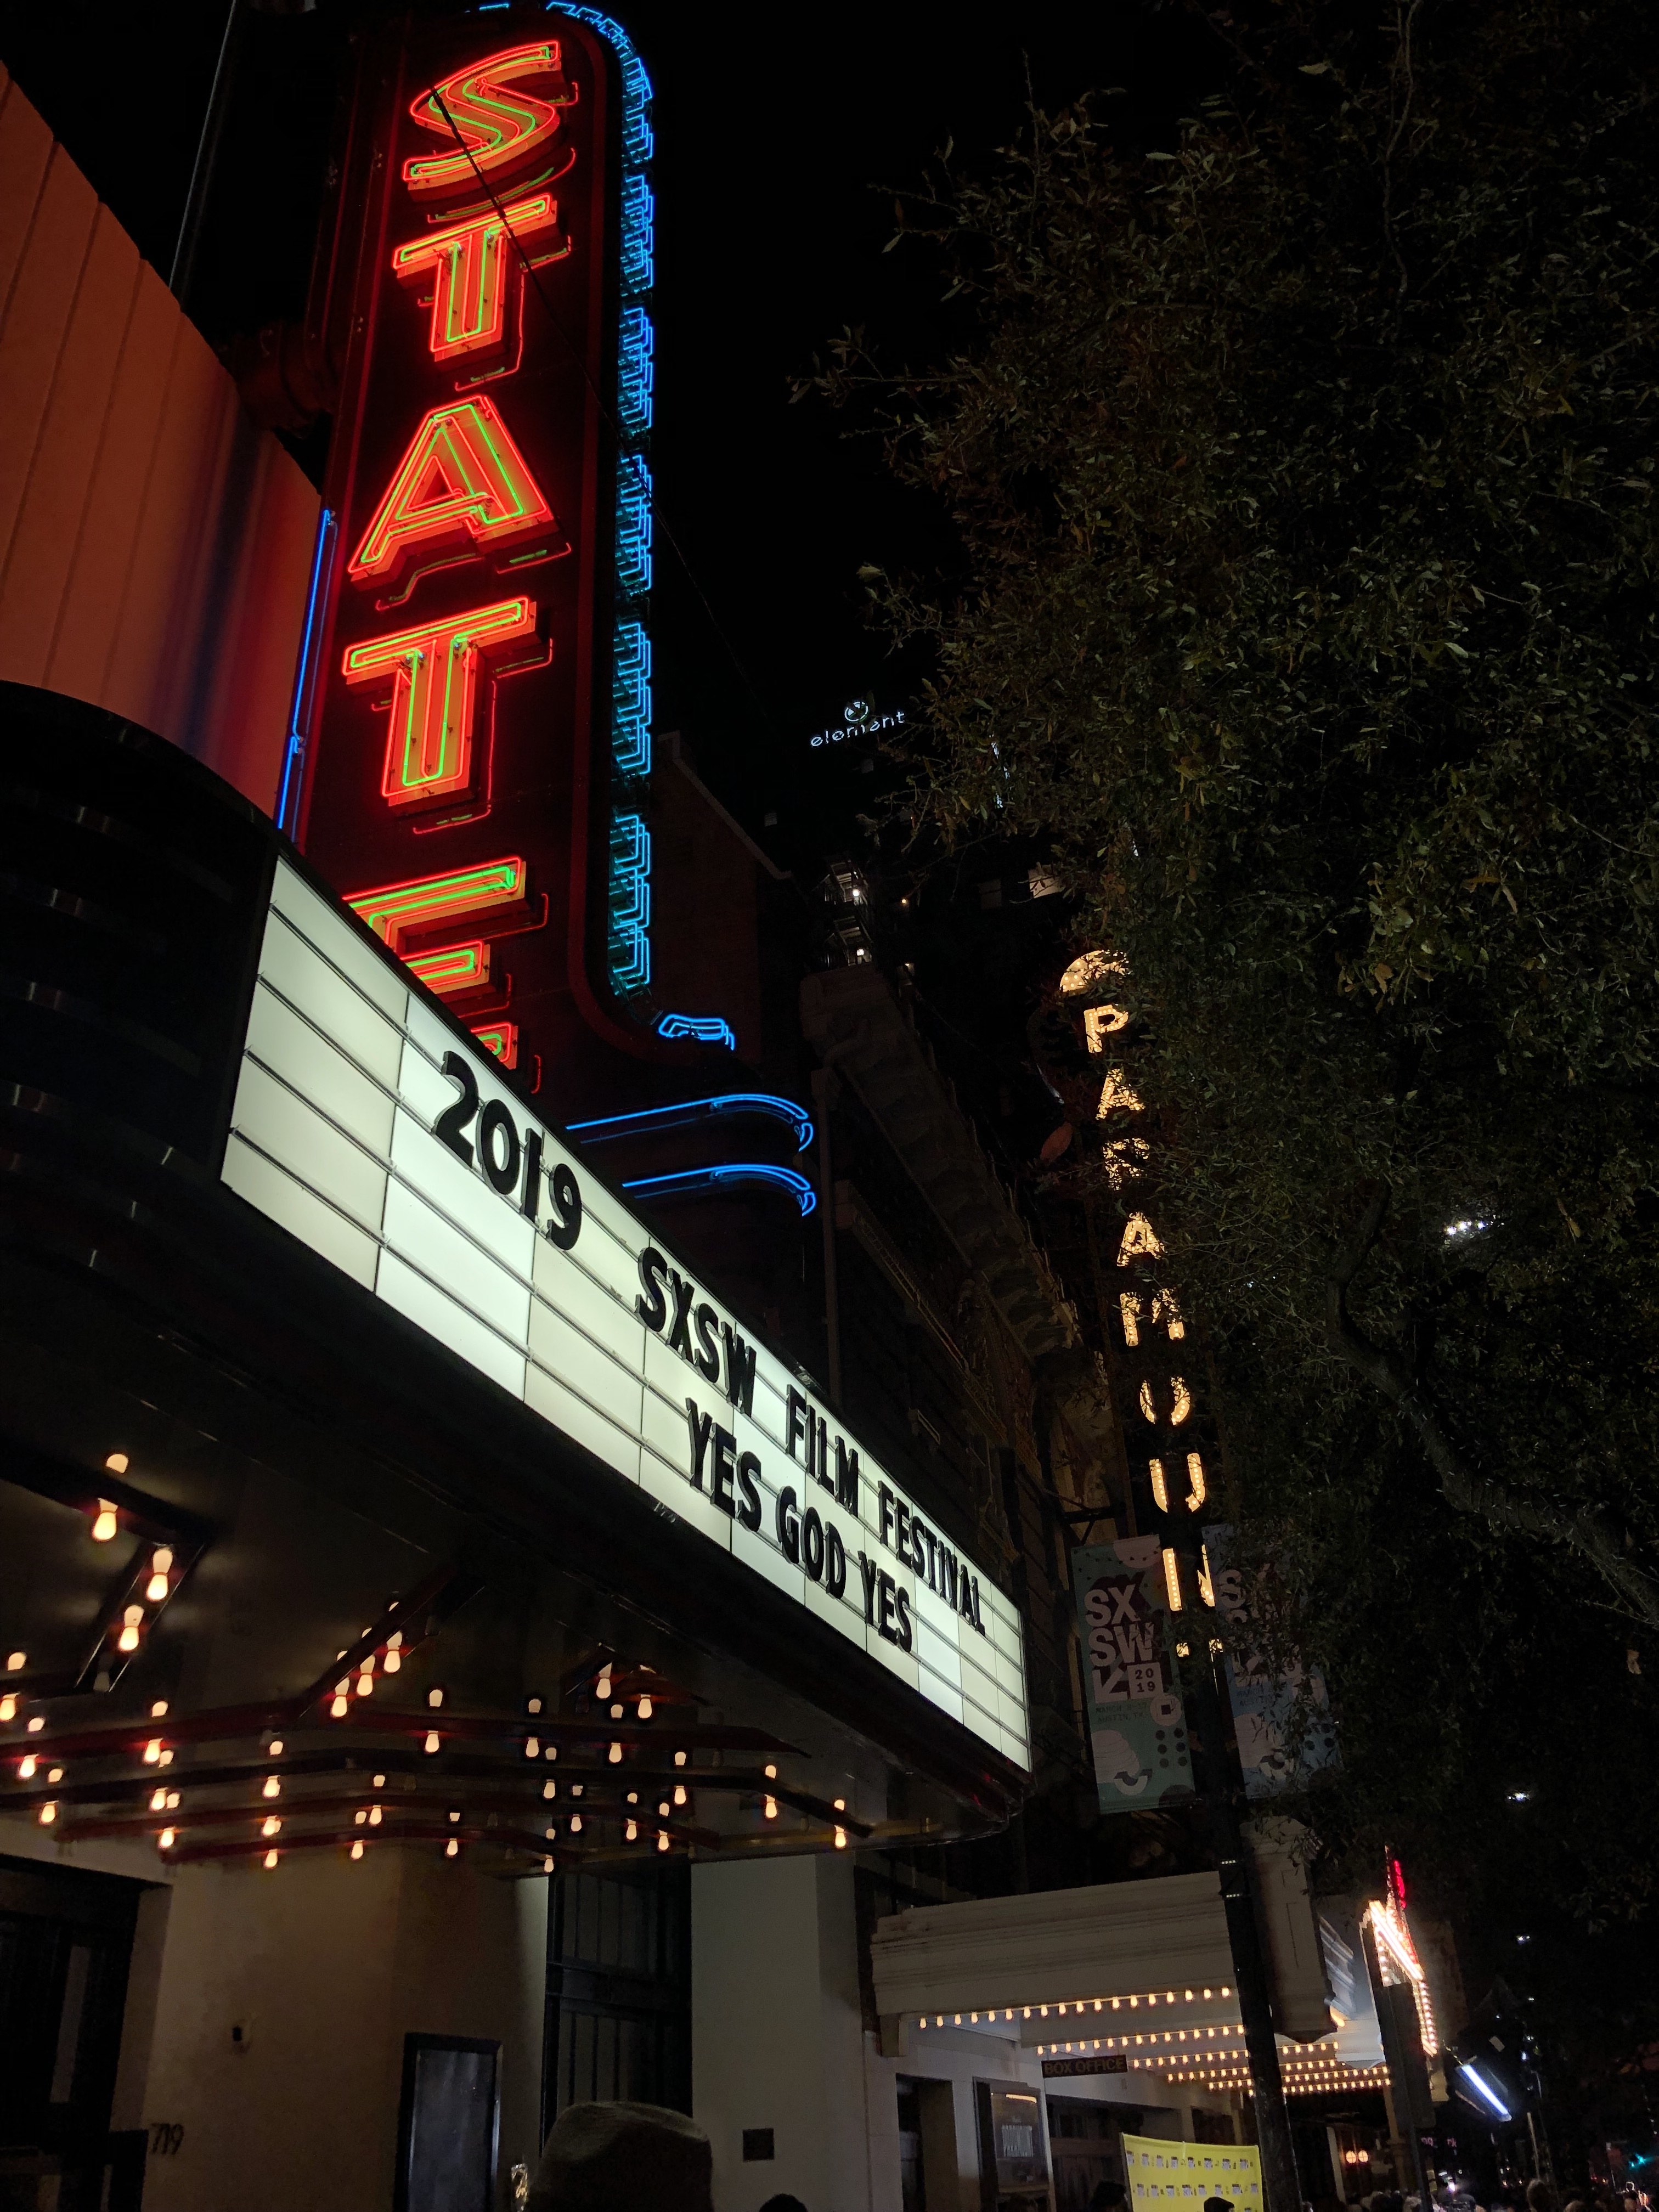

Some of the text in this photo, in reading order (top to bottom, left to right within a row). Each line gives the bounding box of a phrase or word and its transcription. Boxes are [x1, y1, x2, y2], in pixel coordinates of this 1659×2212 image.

[339, 41, 561, 1069] STATE
[432, 1050, 986, 1637] 2019 SXSW FILM FESTIVAL
[1084, 1005, 1223, 1696] PARAMOUN
[686, 1397, 912, 1653] YES GOD YES
[1084, 1583, 1142, 1627] SX
[1088, 1622, 1154, 1667] SW
[1135, 1667, 1154, 1680] 20
[1137, 1681, 1156, 1692] 19
[1044, 2058, 1124, 2074] BOX OFFICE
[152, 2122, 184, 2155] 719
